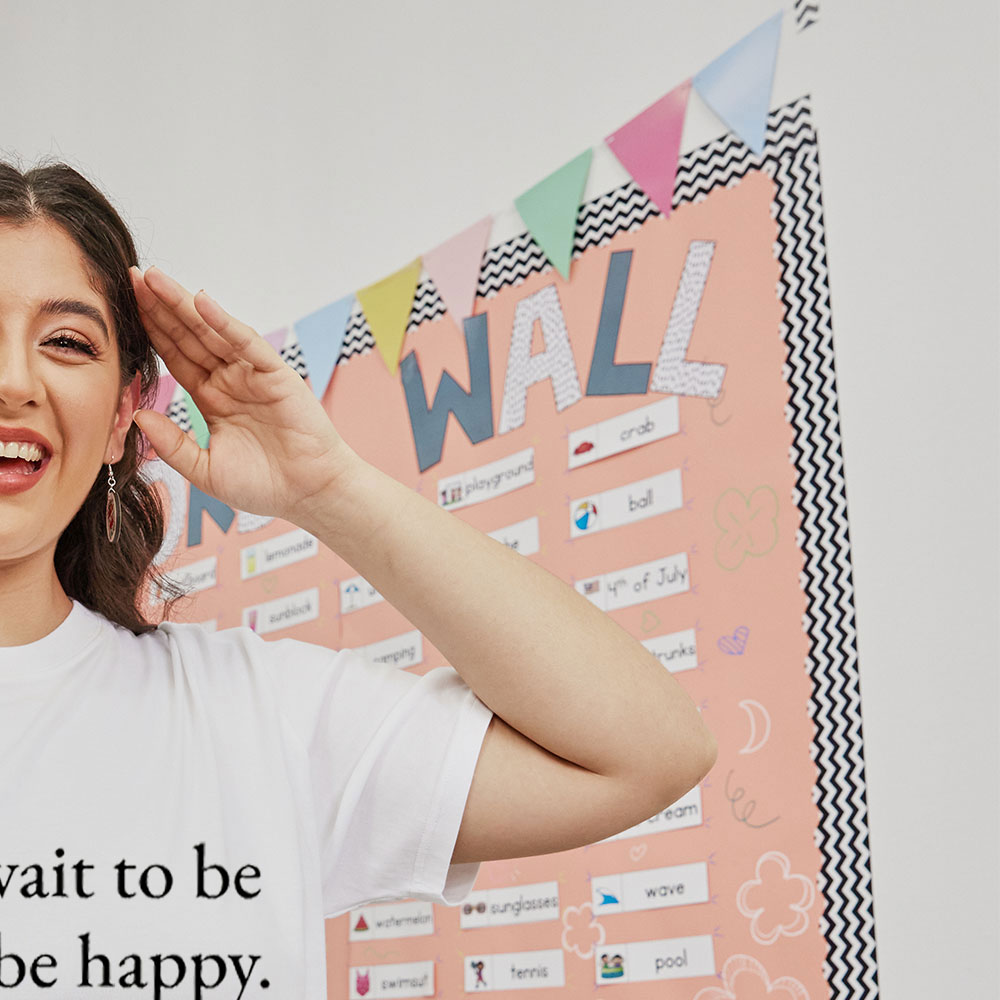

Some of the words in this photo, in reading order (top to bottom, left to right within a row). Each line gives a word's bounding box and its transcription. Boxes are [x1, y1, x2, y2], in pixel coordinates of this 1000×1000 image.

[400, 238, 727, 473] WALL
[619, 417, 655, 442] crab
[464, 453, 534, 496] playground
[628, 488, 655, 512] ball
[633, 573, 649, 593] of
[656, 566, 689, 587] July
[114, 859, 174, 899] to
[194, 842, 262, 899] be
[645, 881, 685, 899] wave
[490, 894, 559, 917] sunglasses
[376, 911, 433, 929] watermelon
[510, 963, 549, 981] tennis
[655, 948, 688, 975] pool
